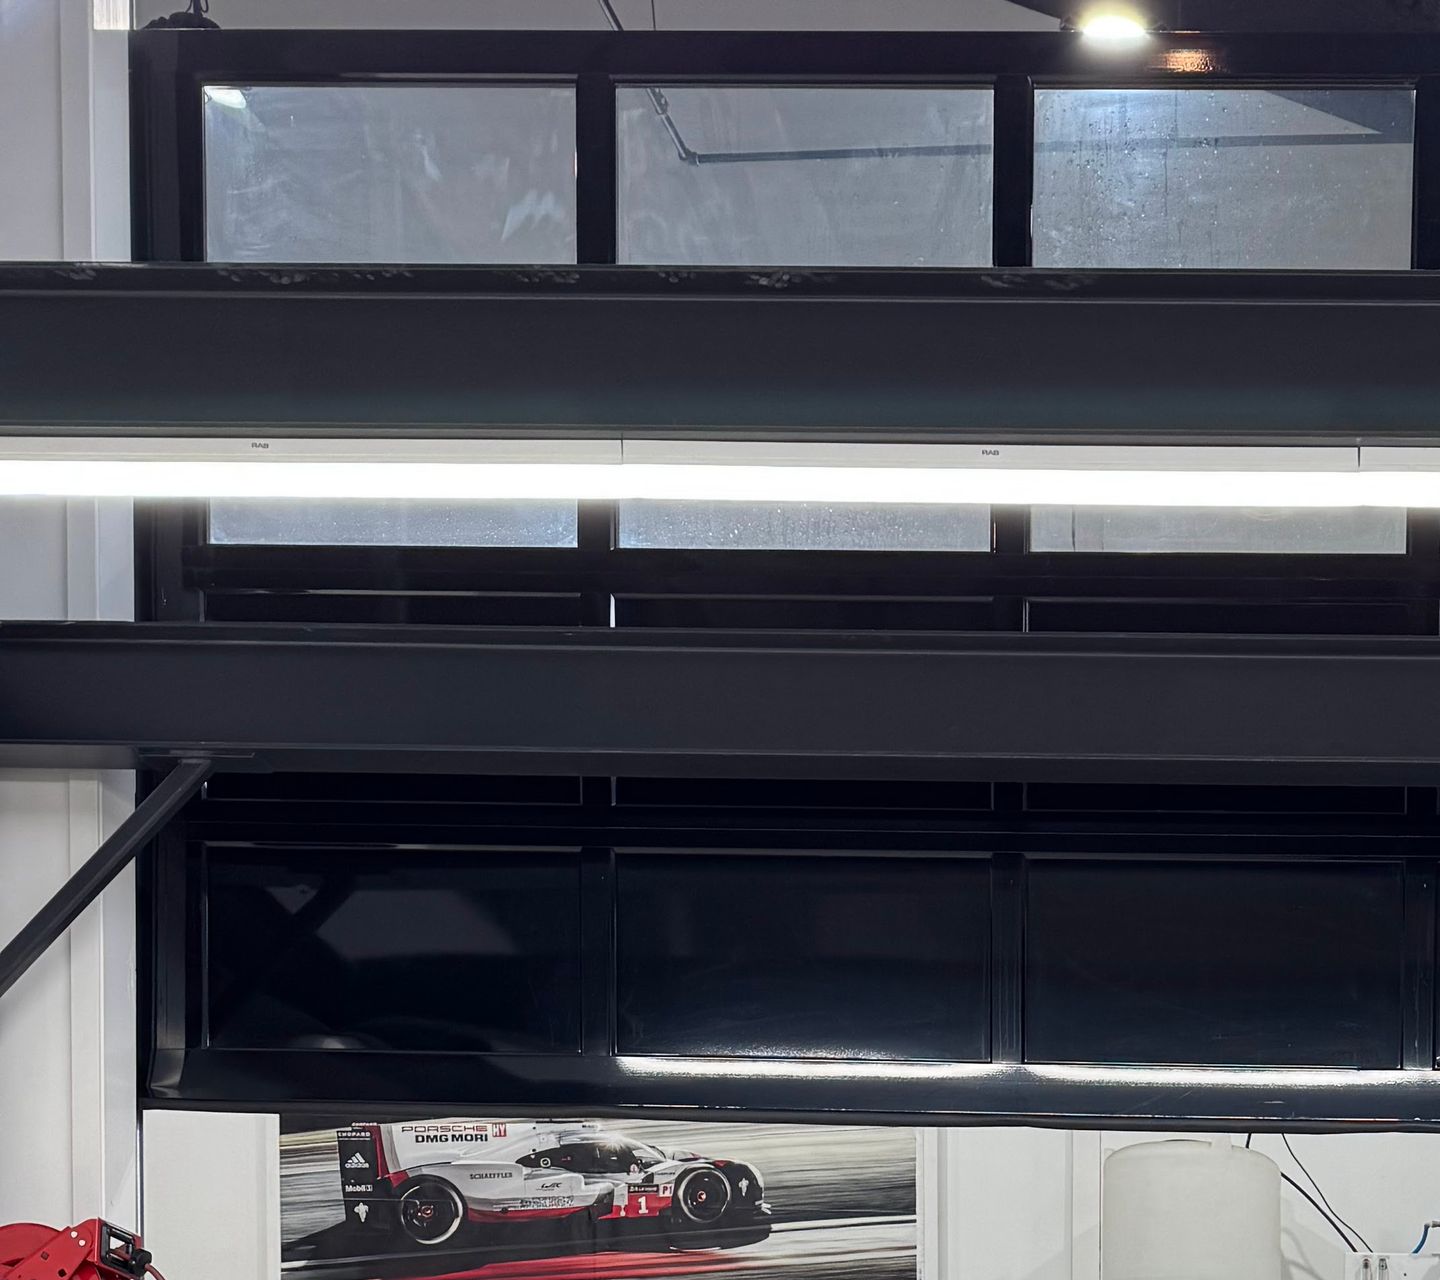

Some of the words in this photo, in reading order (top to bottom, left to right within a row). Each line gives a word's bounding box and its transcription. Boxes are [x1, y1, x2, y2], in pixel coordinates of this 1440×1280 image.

[415, 1135, 448, 1143] DMG
[451, 1134, 488, 1143] MORI
[637, 1195, 649, 1214] 1
